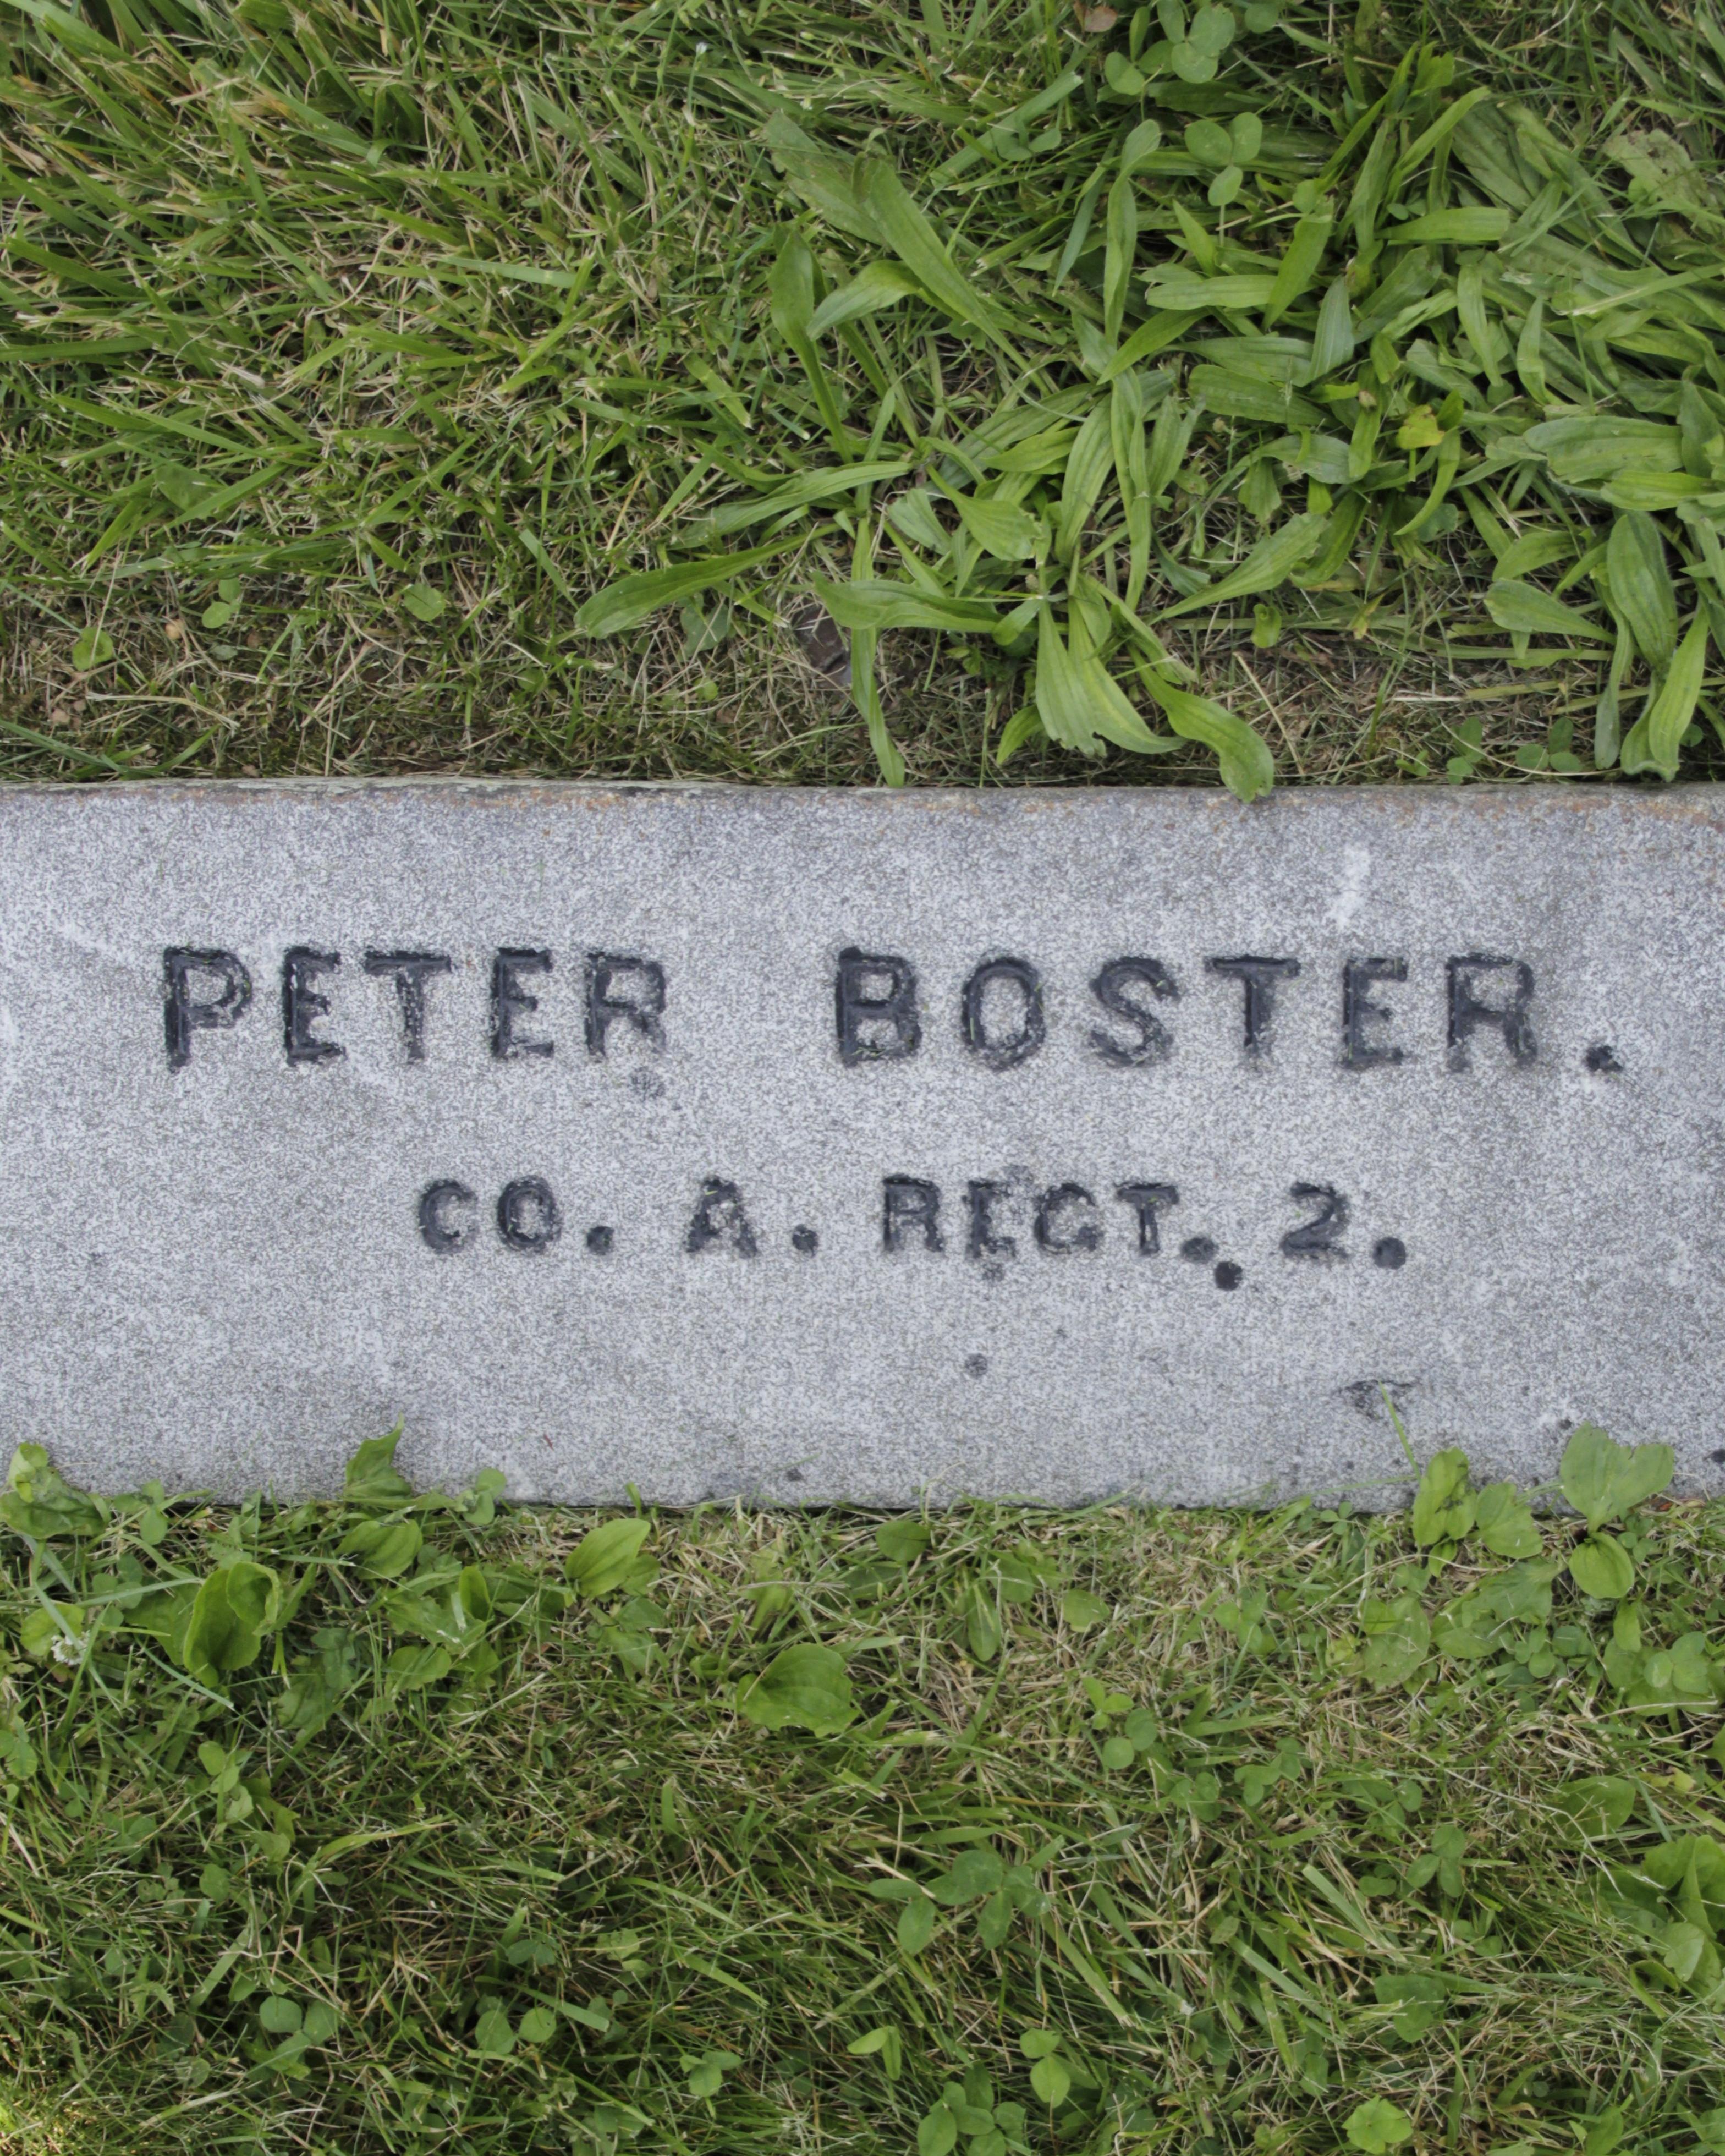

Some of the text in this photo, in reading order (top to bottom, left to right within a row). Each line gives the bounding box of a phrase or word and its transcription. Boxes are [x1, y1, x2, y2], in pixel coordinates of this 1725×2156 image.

[163, 945, 667, 1072] PETER
[418, 1176, 614, 1255] CO.
[685, 1176, 819, 1258] A.
